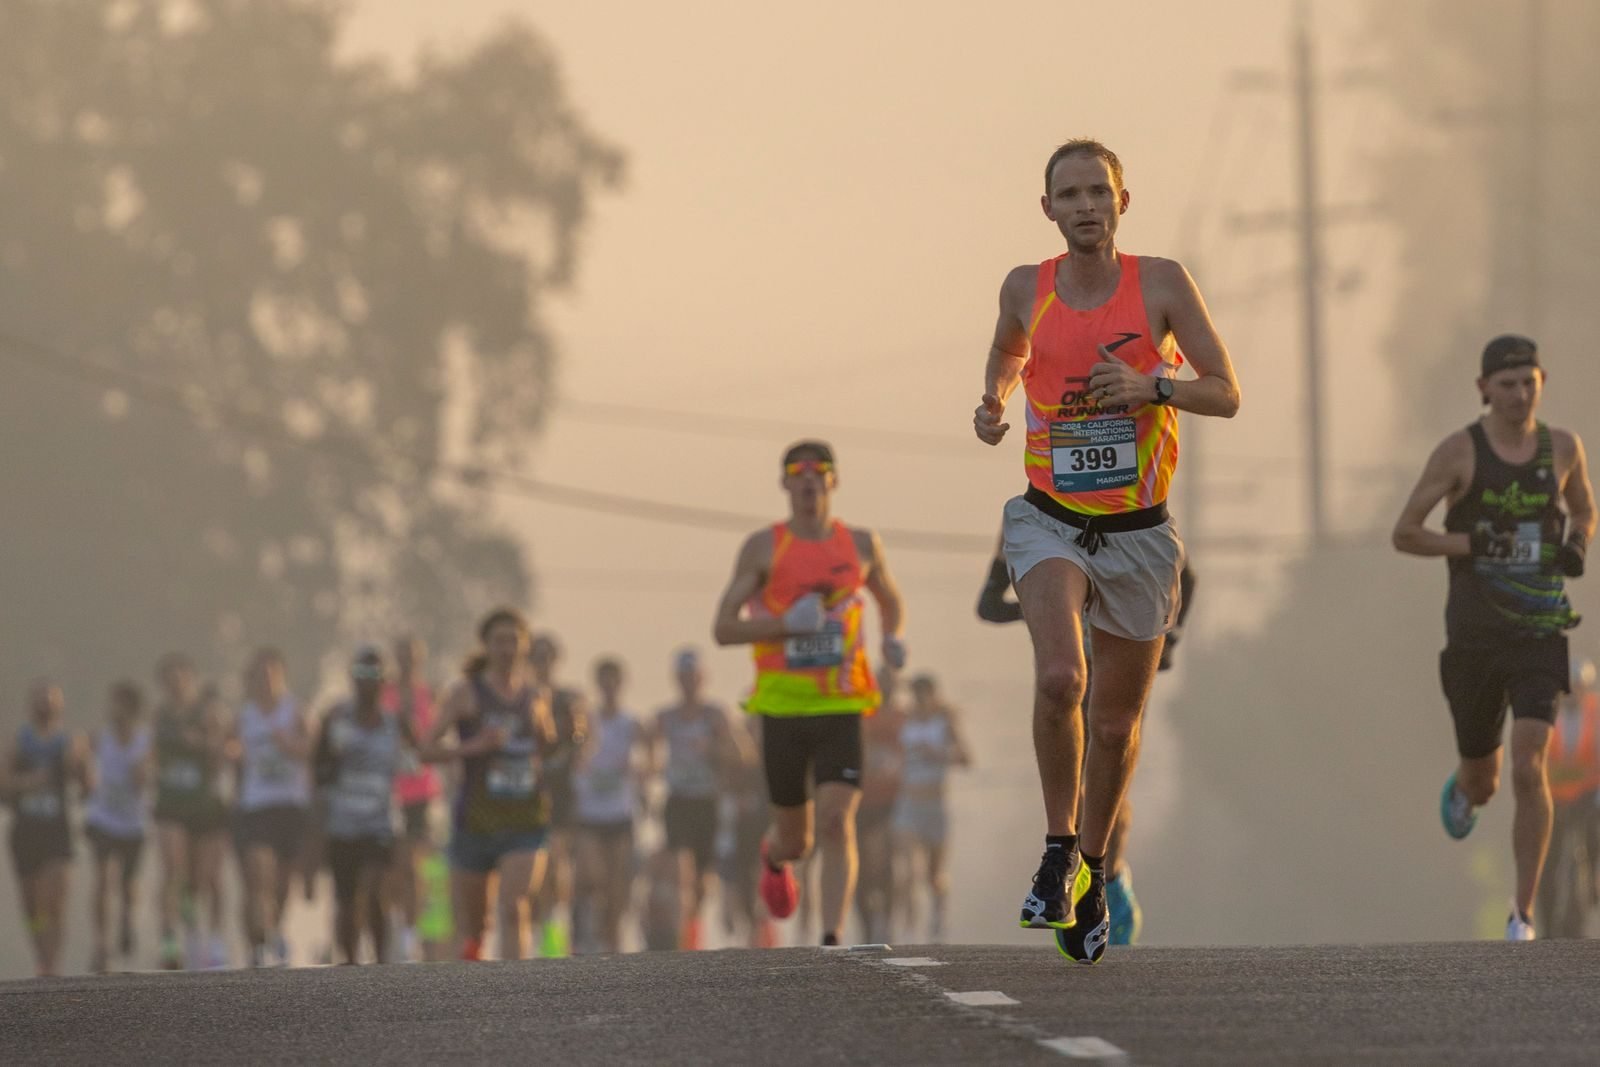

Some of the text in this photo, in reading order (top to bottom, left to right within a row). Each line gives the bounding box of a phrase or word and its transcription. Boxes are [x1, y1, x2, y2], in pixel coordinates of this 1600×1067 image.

[1062, 423, 1081, 431] 2024
[1087, 419, 1134, 428] CALIFORNIA
[1073, 426, 1134, 437] INTERNATIONAL
[1090, 433, 1135, 443] MARATHON
[1070, 446, 1117, 472] 399
[1096, 474, 1138, 485] MARATHON
